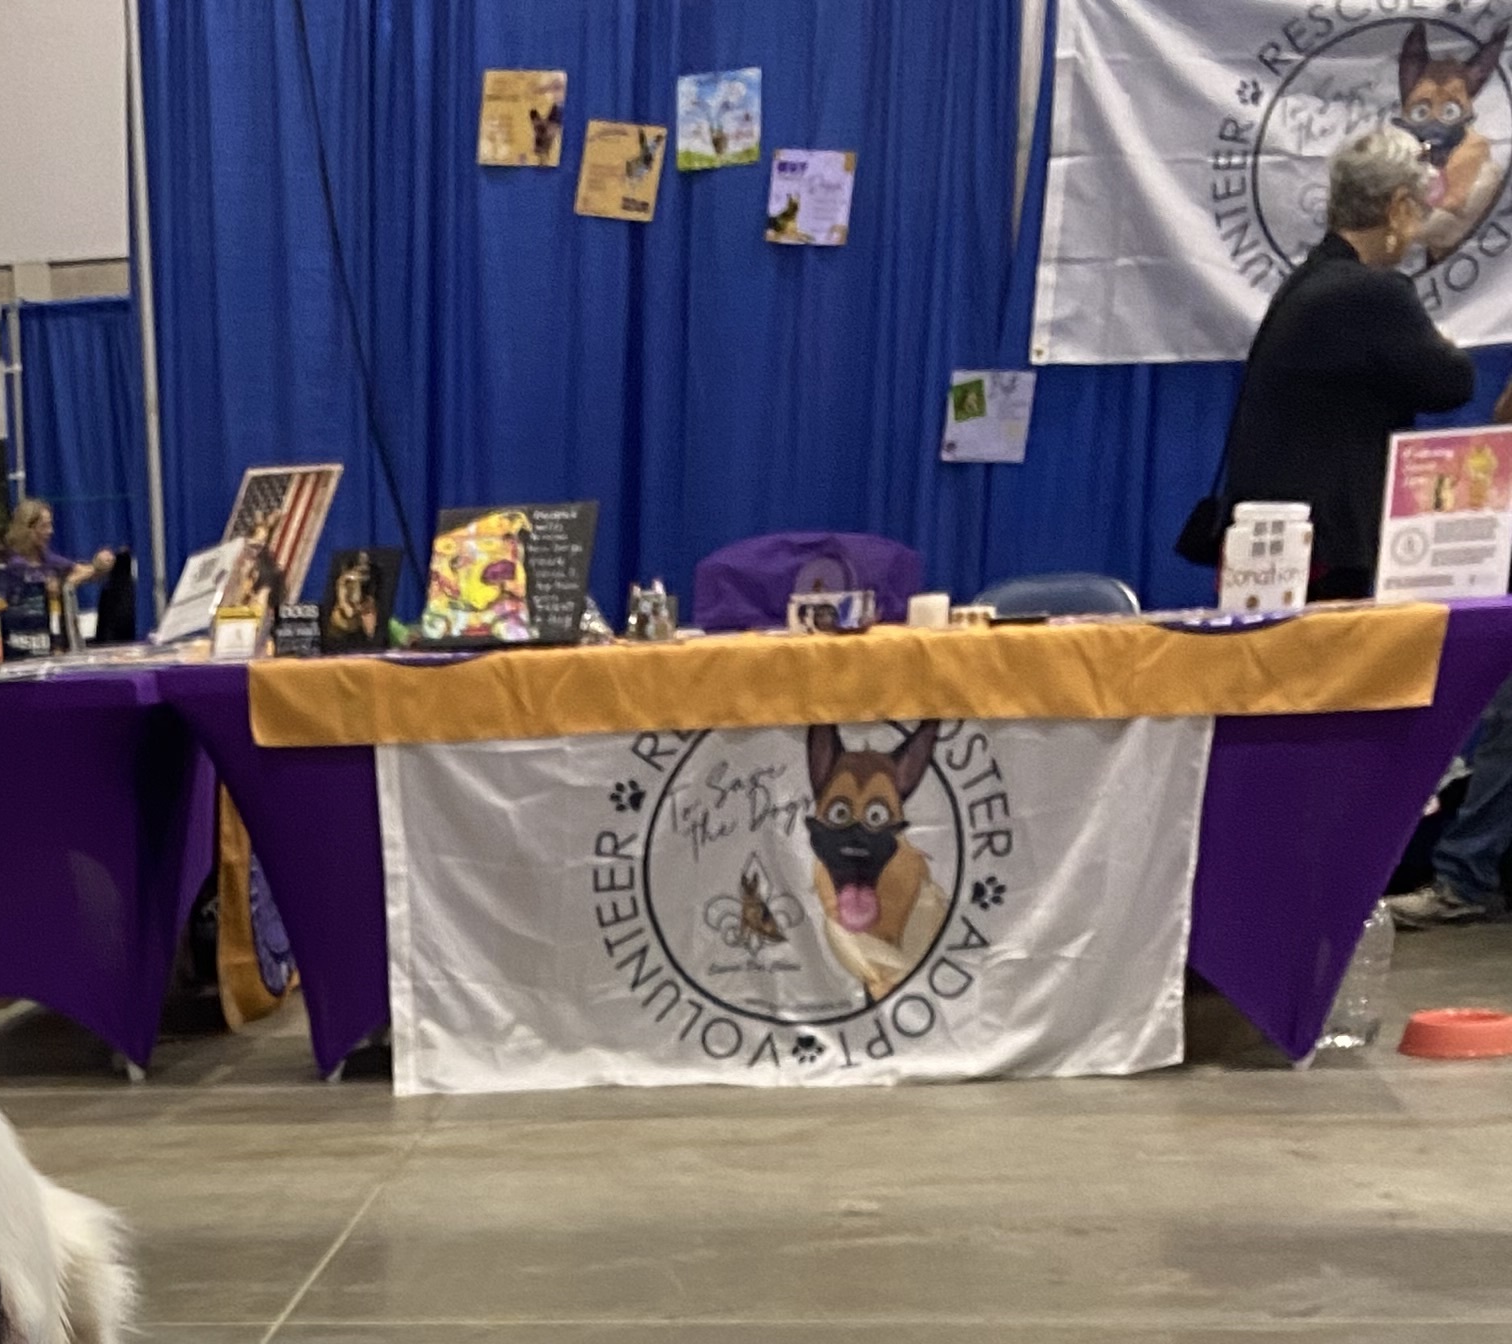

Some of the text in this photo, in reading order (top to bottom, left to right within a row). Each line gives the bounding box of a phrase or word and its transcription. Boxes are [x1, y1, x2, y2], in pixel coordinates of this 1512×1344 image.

[1258, 0, 1432, 77] RESC
[1212, 115, 1286, 288] UNTEER
[936, 718, 1013, 860] STER
[593, 831, 781, 1069] VOLUNTEER
[837, 915, 988, 1068] ADOPT
